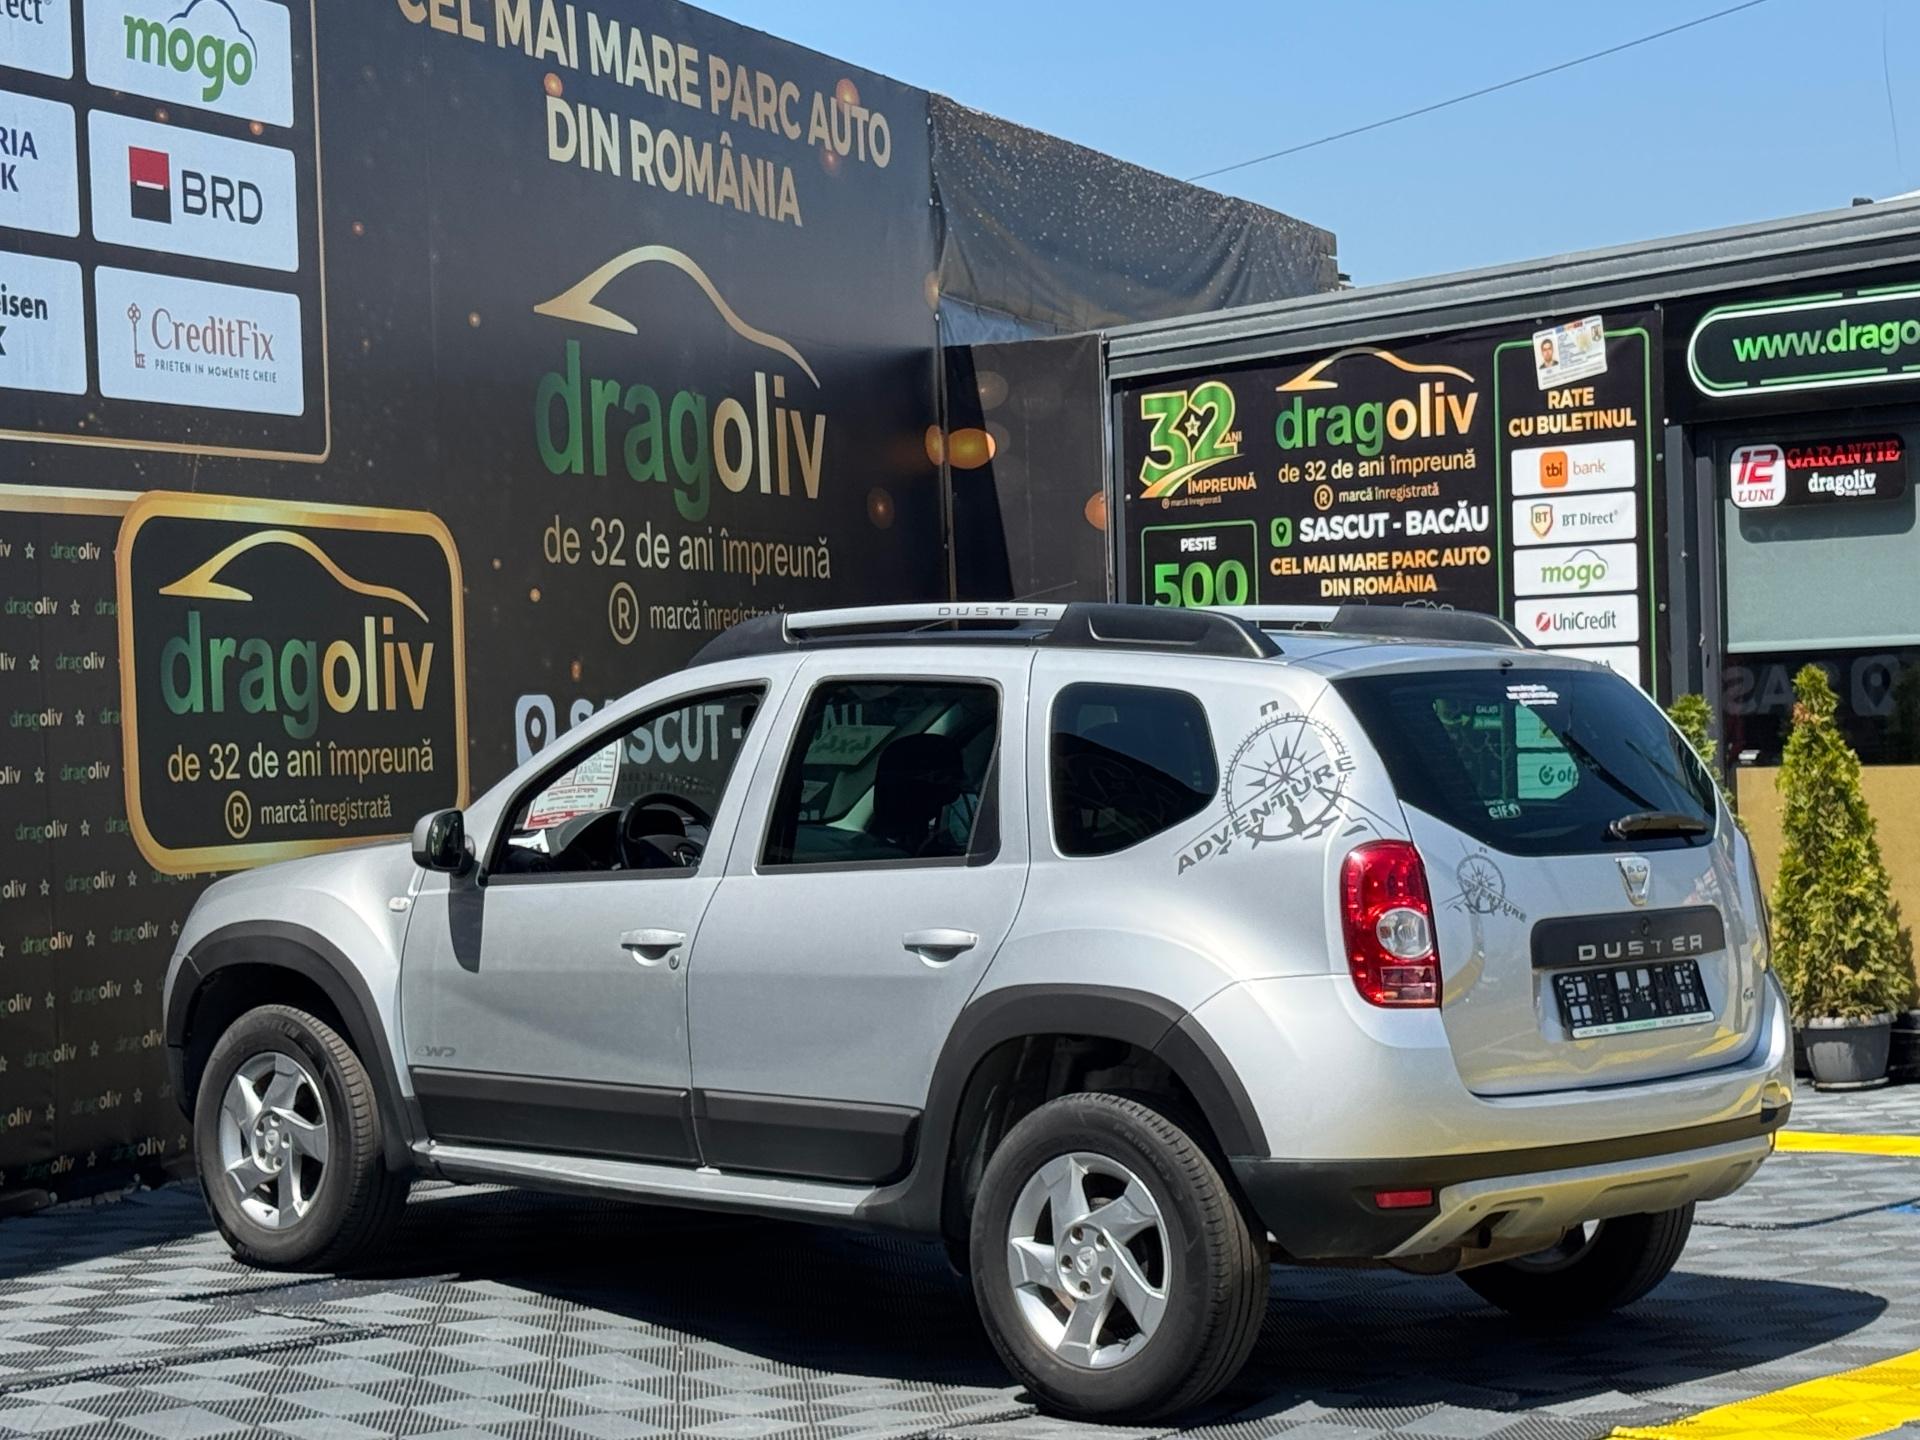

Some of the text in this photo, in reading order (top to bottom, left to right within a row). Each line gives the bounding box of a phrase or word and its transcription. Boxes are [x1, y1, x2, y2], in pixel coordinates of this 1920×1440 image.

[124, 15, 252, 102] mogo
[495, 0, 579, 70] MAI
[586, 11, 701, 110] MARE
[708, 53, 802, 140] PARC
[808, 91, 892, 169] AUTO
[545, 95, 803, 227] DIN ROMÂNIA
[181, 169, 263, 225] BRD
[0, 283, 48, 320] isen
[151, 308, 275, 361] CreditFix
[155, 359, 277, 383] PRIETEN IN MOMENTE CHEIE
[1547, 386, 1595, 410] RATE
[535, 339, 827, 522] dragoliv
[1275, 381, 1479, 456] dragoliv
[1508, 407, 1637, 438] CU BULETINUL
[1139, 381, 1235, 488] 32
[1224, 431, 1242, 443] ANI
[1278, 448, 1476, 483] de 32 de ani împreună
[1545, 459, 1606, 477] tbi bank
[1737, 449, 1778, 486] 12
[1787, 440, 1901, 470] GARANTIE
[1338, 487, 1373, 503] marcă
[1374, 482, 1440, 503] înregistrată
[1738, 489, 1775, 503] LUNI
[1808, 469, 1876, 496] dragoliv
[1299, 512, 1390, 543] SASCUT
[1405, 500, 1489, 537] BACĂU
[1534, 511, 1549, 524] BT
[1562, 513, 1577, 527] BT
[50, 542, 101, 563] dragoliv
[543, 515, 832, 587] de 32 de ani împreună
[1180, 536, 1217, 552] PESTE
[1269, 546, 1491, 576] CEL MAI MARE PARC AUTO
[1154, 560, 1248, 608] 500
[1320, 571, 1438, 598] DIN ROMÂNIA
[1541, 564, 1606, 589] mogo
[4, 597, 58, 619] dragoliv
[650, 599, 702, 631] marcă
[938, 607, 1048, 616] DUSTER
[1553, 610, 1617, 631] UniCredit
[55, 652, 105, 673] dragoliv
[160, 610, 434, 739] dragoliv
[10, 708, 63, 731] dragoliv
[60, 761, 110, 783] dragoliv
[167, 739, 434, 783] de 32 de ani împreună
[261, 799, 308, 826] marcă
[310, 795, 392, 827] înregistrată
[1177, 755, 1356, 876] ADVENTURE
[15, 820, 68, 842] dragoliv
[65, 871, 116, 893] dragoliv
[21, 921, 159, 955] dragoliv dragoliv
[1578, 934, 1702, 961] DUSTER
